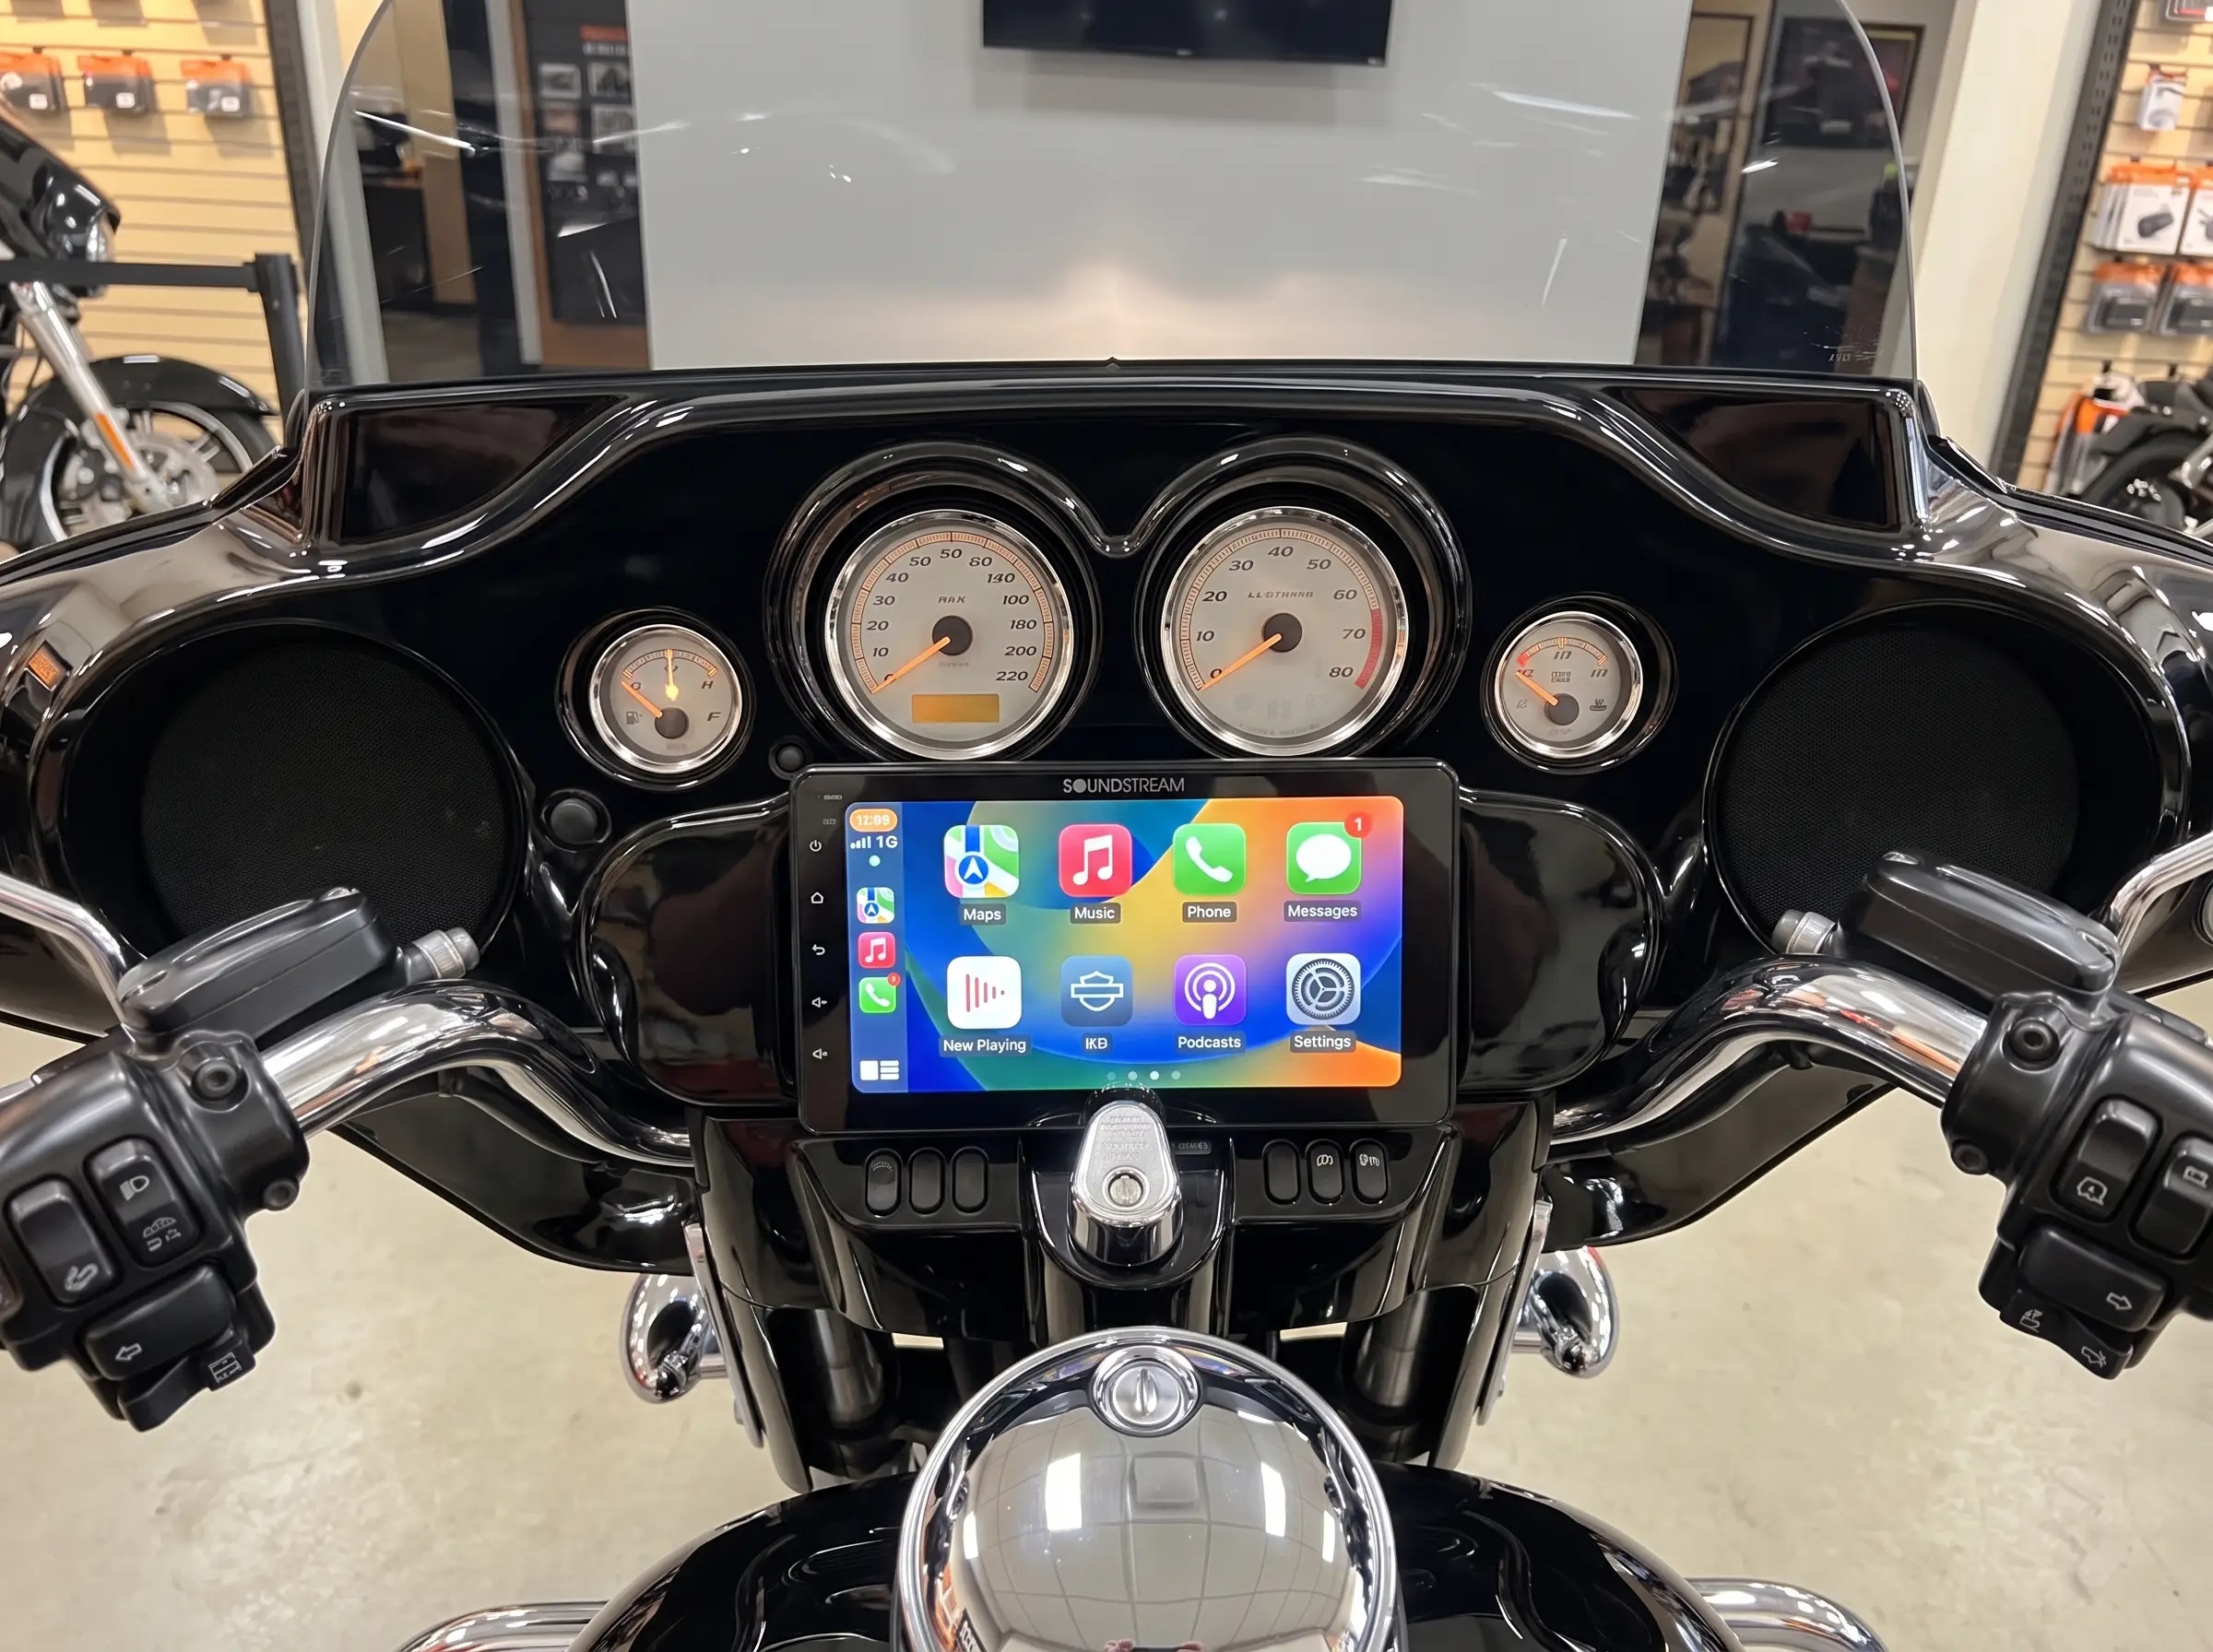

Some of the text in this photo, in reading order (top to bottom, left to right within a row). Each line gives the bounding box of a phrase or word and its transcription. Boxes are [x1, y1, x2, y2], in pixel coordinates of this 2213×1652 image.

[940, 549, 963, 559] 50
[1267, 546, 1294, 558] 40
[908, 556, 932, 568] 50
[1227, 559, 1255, 572] 30
[1307, 559, 1331, 570] 50
[884, 572, 910, 584] 40
[987, 572, 1016, 584] 140
[1002, 595, 1030, 606] 100
[1201, 590, 1228, 603] 20
[1332, 589, 1358, 600] 60
[871, 595, 896, 607] 30
[866, 620, 889, 631] 20
[1010, 619, 1037, 630] 180
[1196, 630, 1215, 642] 10
[1343, 628, 1367, 640] 70
[872, 647, 889, 657] 10
[1004, 645, 1037, 656] 200
[995, 670, 1029, 681] 220
[1329, 667, 1354, 678] 80
[701, 680, 714, 690] H
[706, 712, 722, 722] F
[1062, 777, 1185, 794] SOUNDSTREAM
[1354, 817, 1362, 832] 1
[875, 834, 898, 849] 1G
[964, 908, 1002, 924] Maps
[1074, 906, 1116, 919] Music
[1188, 905, 1232, 918] Phone
[1287, 904, 1358, 920] Messages
[943, 1038, 1026, 1054] New Playing
[1178, 1035, 1242, 1049] Podcasts
[1294, 1034, 1352, 1051] Settings
